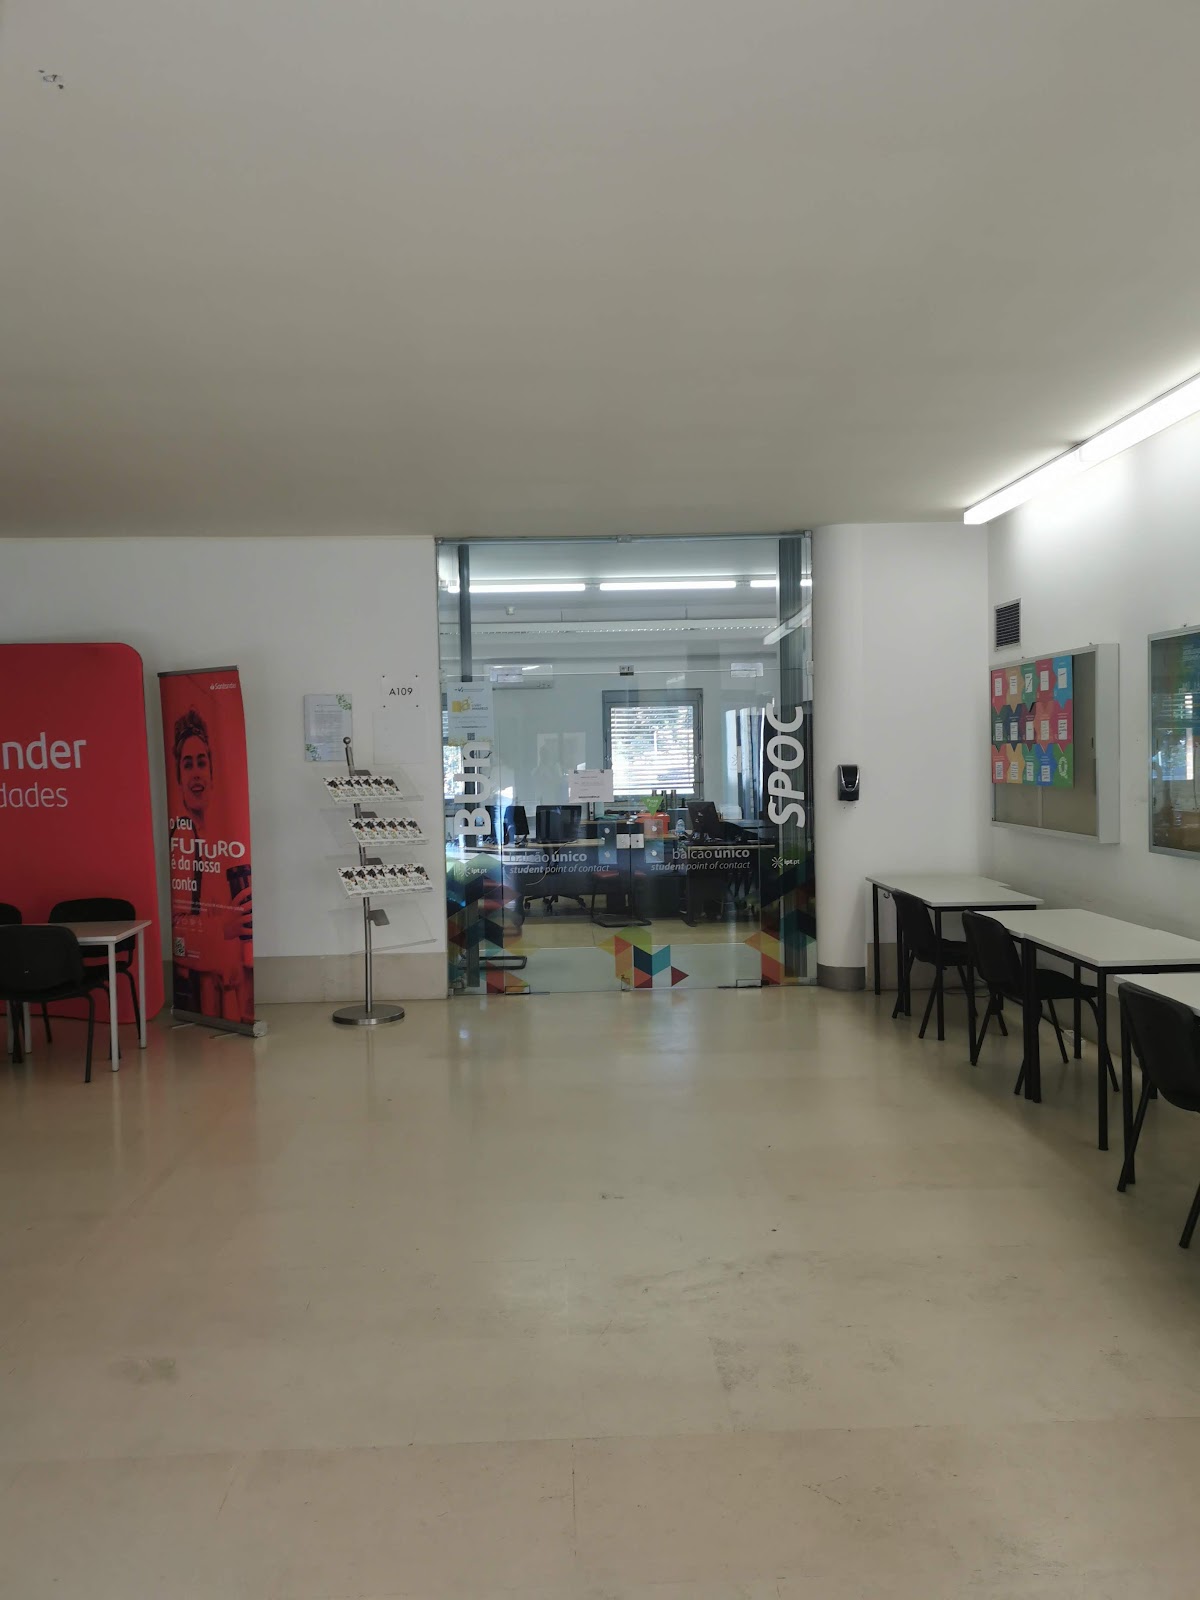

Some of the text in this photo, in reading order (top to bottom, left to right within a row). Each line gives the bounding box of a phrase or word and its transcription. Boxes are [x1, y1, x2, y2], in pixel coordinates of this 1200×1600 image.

[389, 687, 413, 696] A109
[766, 702, 806, 829] SPOC
[170, 816, 193, 830] o teu
[170, 838, 245, 858] FUTURO
[714, 847, 750, 859] único
[551, 850, 588, 862] único
[171, 854, 220, 873] é da nossa
[509, 863, 610, 875] student point of contact
[650, 861, 751, 872] student point of contact
[172, 877, 197, 891] conta
